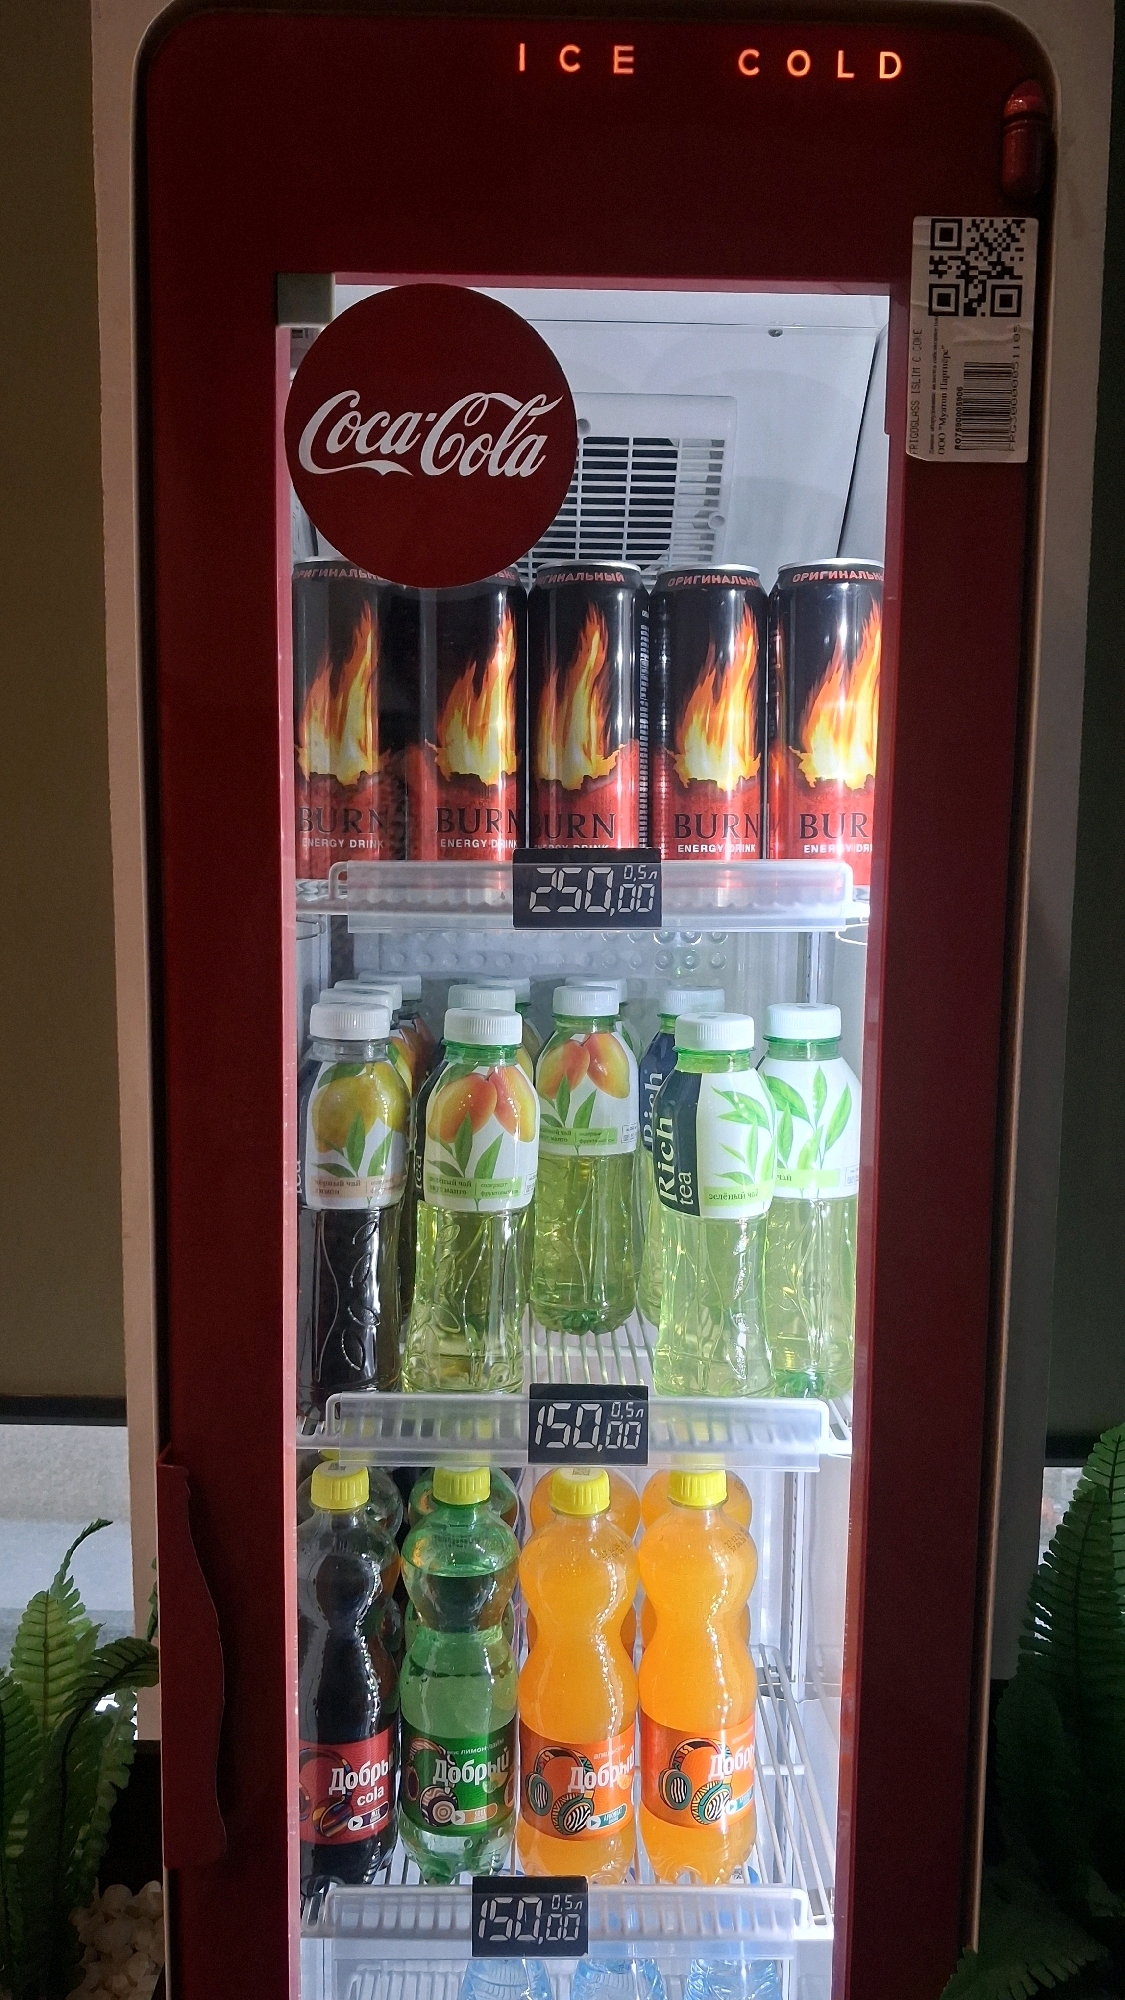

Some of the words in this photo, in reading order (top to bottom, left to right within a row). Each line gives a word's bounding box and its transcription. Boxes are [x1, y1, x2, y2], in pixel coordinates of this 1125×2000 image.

[518, 42, 635, 75] ICE
[737, 48, 902, 80] COLD
[298, 389, 564, 478] Coca-Cola
[909, 401, 920, 455] FRIGOGLASS
[937, 432, 946, 455] ООО
[299, 807, 388, 835] BURN
[673, 813, 759, 839] BURN
[800, 812, 869, 839] BUR
[301, 837, 345, 848] ENERGY
[349, 838, 384, 849] DRINK
[440, 838, 487, 849] ENERGY
[677, 843, 723, 853] ENERGY
[803, 843, 854, 854] ENERGY
[623, 864, 658, 882] 0,5л
[529, 867, 656, 917] 250,00
[656, 1116, 678, 1203] Rich
[677, 1171, 694, 1206] tea
[708, 1189, 746, 1202] зелёный
[610, 1401, 645, 1420] 0,5л
[534, 1402, 642, 1453] 150,00
[432, 1746, 510, 1794] Добрый
[356, 1785, 385, 1806] cola
[551, 1894, 583, 1913] 0,5л
[478, 1896, 581, 1945] 150,00
